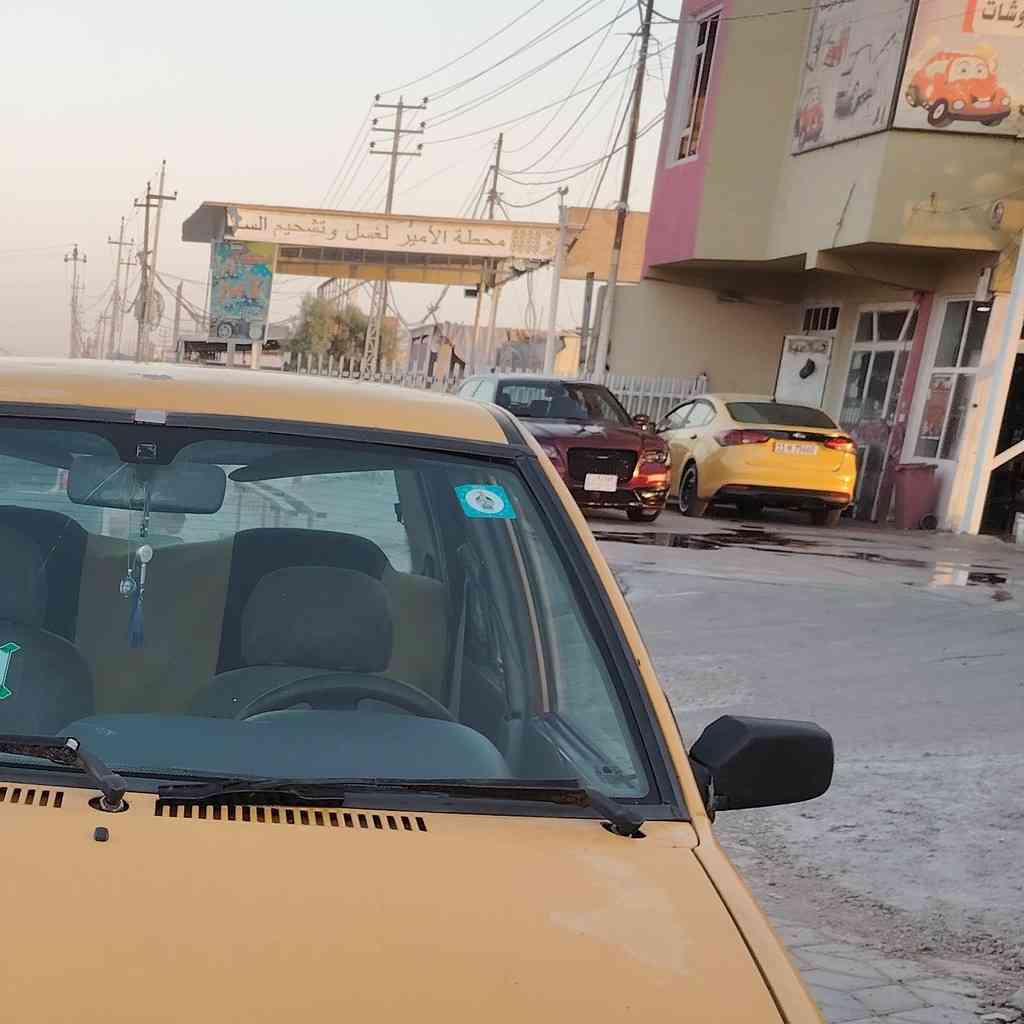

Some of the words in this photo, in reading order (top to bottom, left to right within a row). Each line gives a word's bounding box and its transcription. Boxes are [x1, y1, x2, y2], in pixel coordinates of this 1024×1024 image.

[344, 223, 390, 241] لغسل
[397, 219, 447, 248] الأمير
[454, 228, 505, 247] محطة
